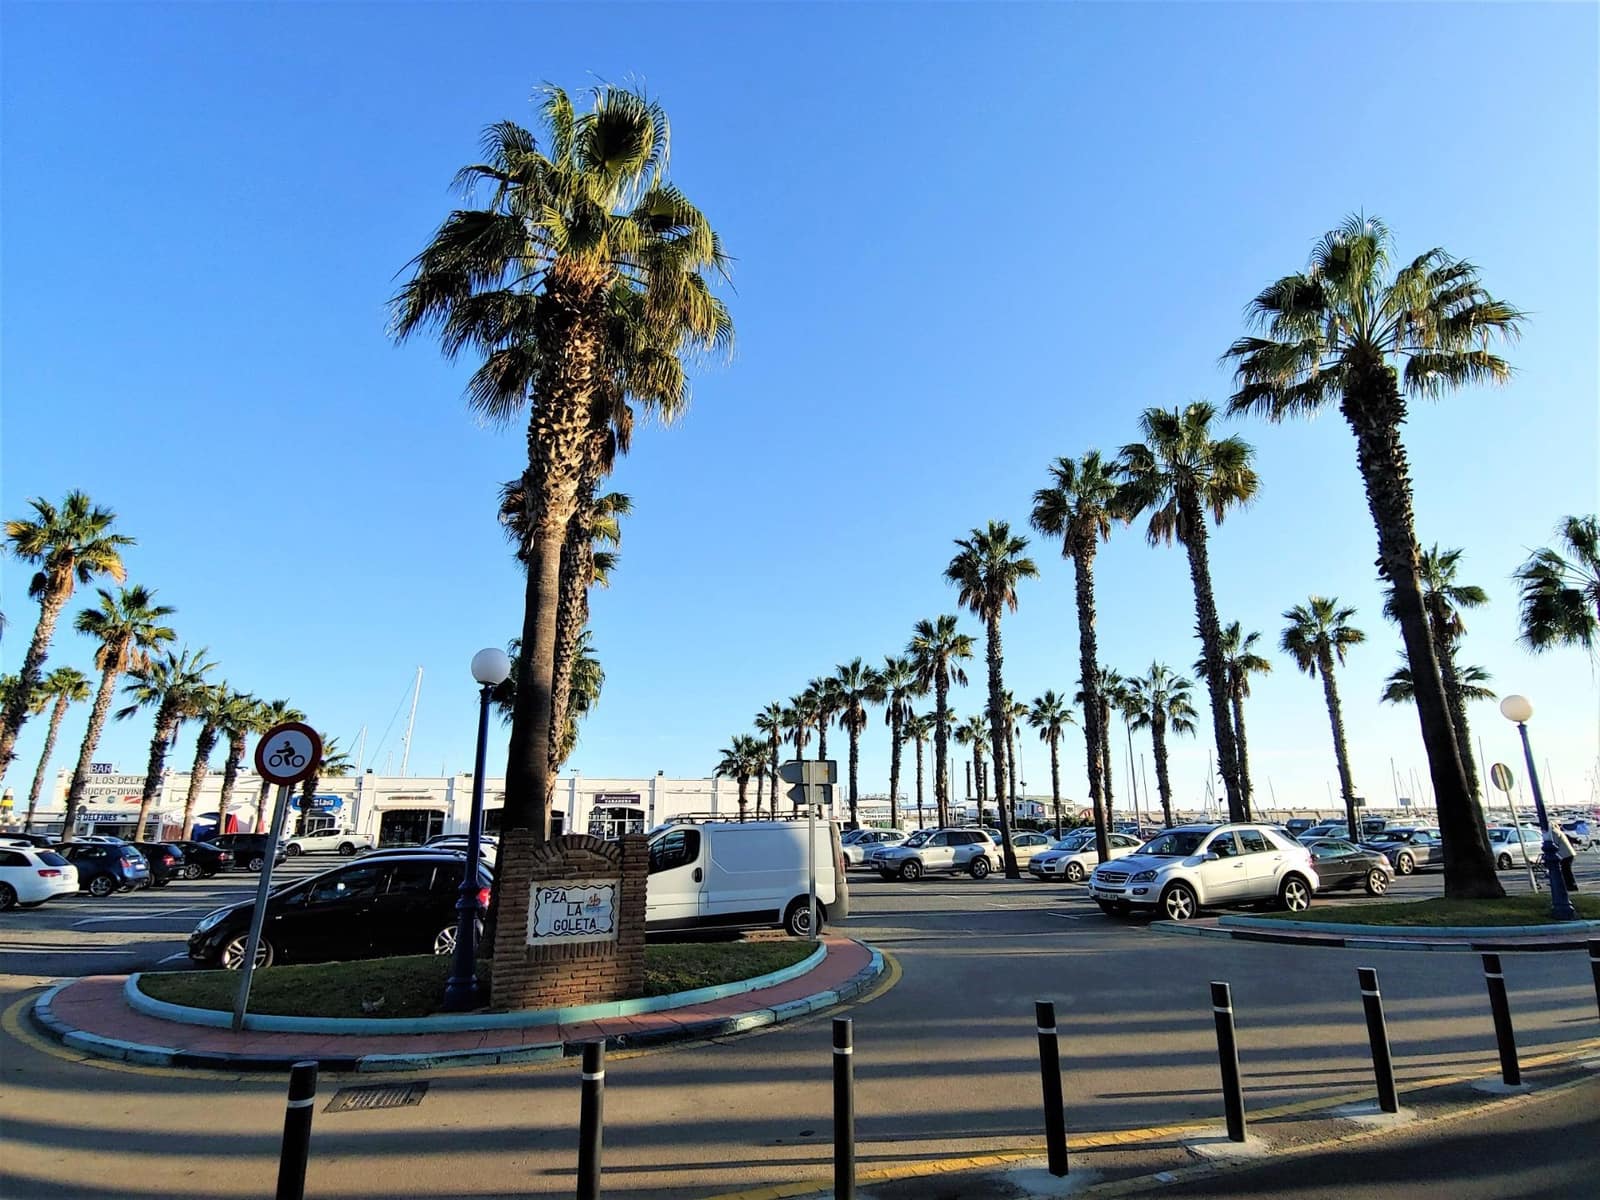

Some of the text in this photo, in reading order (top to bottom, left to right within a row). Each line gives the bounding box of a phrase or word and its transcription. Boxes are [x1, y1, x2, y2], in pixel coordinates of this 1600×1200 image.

[91, 764, 112, 773] BAR
[95, 776, 115, 785] LOS
[544, 891, 567, 904] PZA
[567, 904, 582, 916] LA
[553, 918, 597, 931] GOLETA
